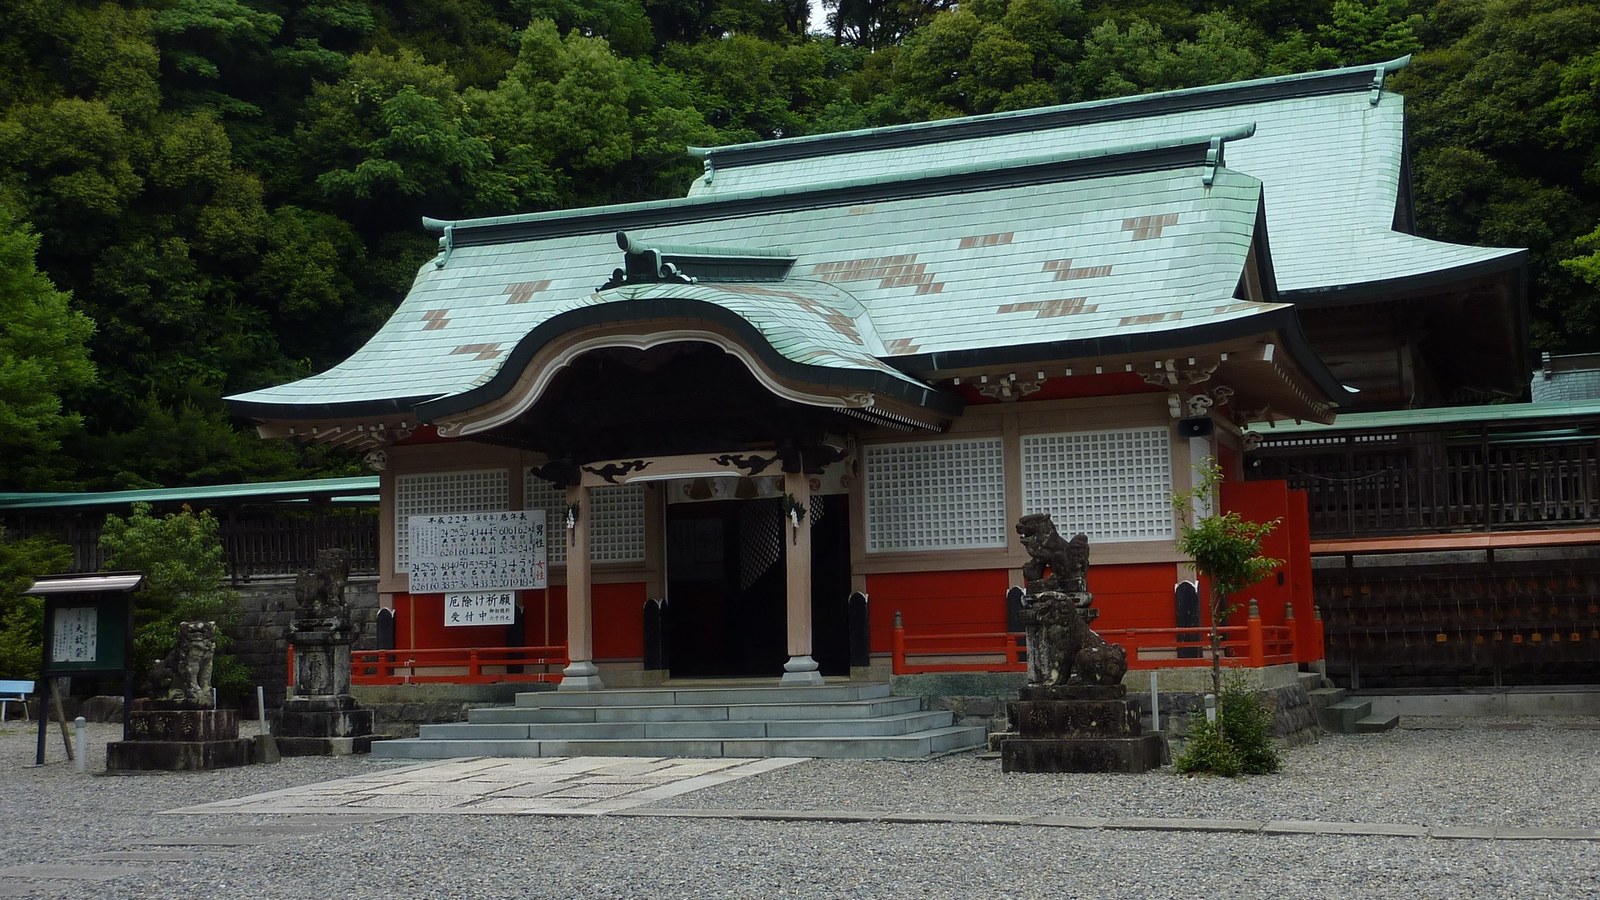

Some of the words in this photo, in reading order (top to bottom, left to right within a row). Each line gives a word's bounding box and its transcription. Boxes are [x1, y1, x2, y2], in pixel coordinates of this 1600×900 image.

[536, 524, 544, 548] 男性
[449, 594, 510, 607] 厄除け祈願
[451, 610, 487, 622] 受付中
